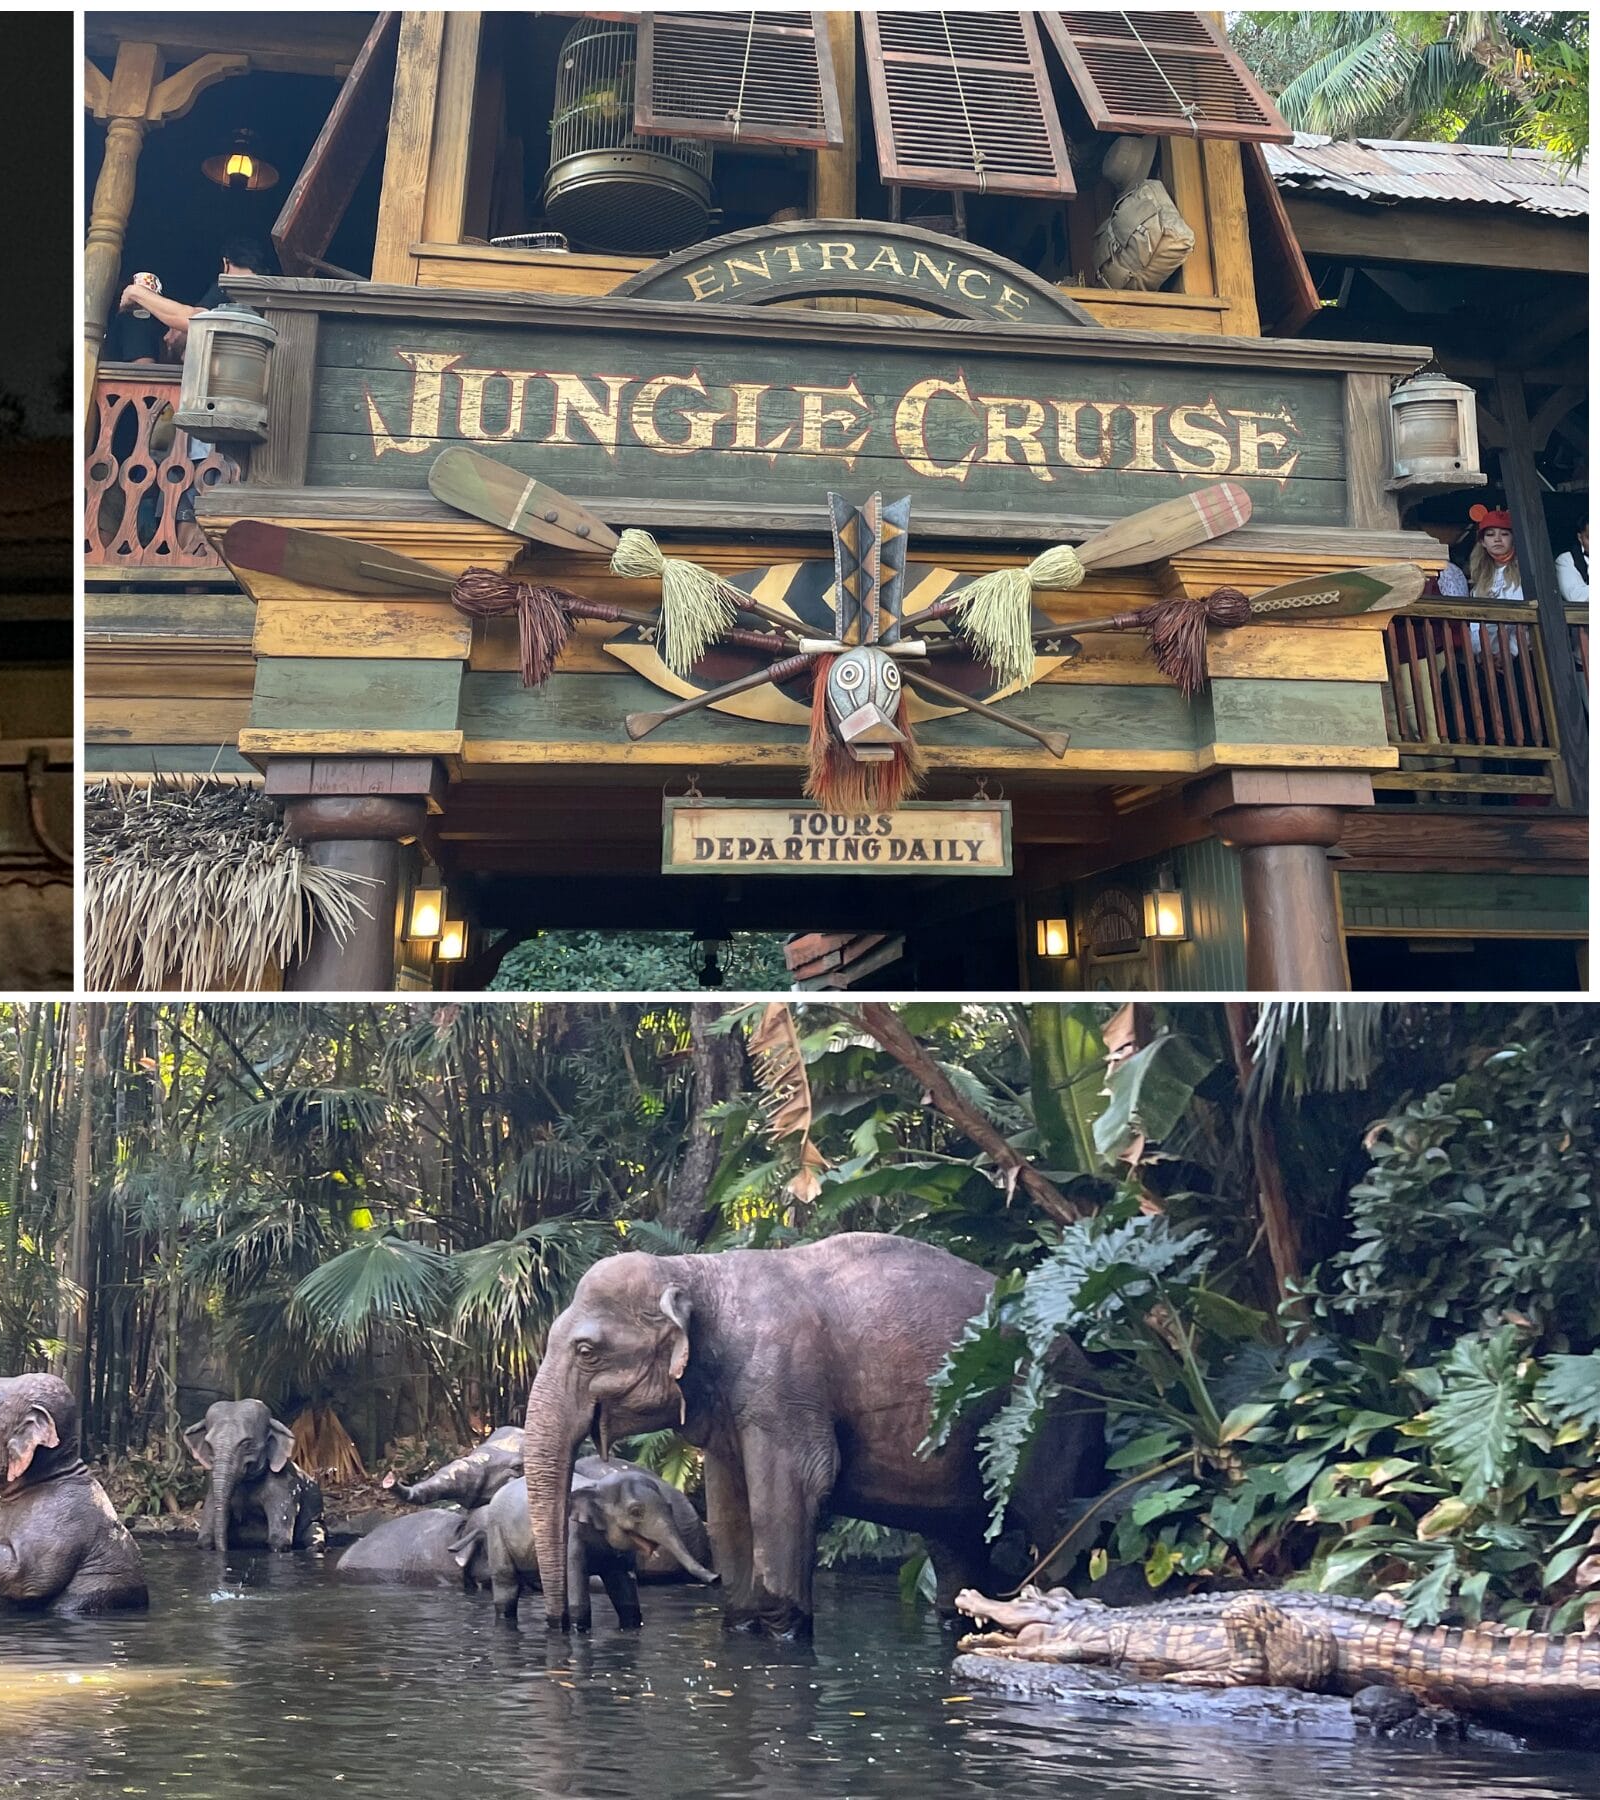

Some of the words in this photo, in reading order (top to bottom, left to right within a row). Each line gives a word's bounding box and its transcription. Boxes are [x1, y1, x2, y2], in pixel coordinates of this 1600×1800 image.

[683, 241, 1031, 322] ENTRANCE
[364, 348, 870, 470] JUNGLE
[893, 368, 1303, 485] CRUISE
[693, 837, 882, 862] DEPARTING
[889, 839, 985, 862] DAILY
[789, 813, 893, 836] TOURS
